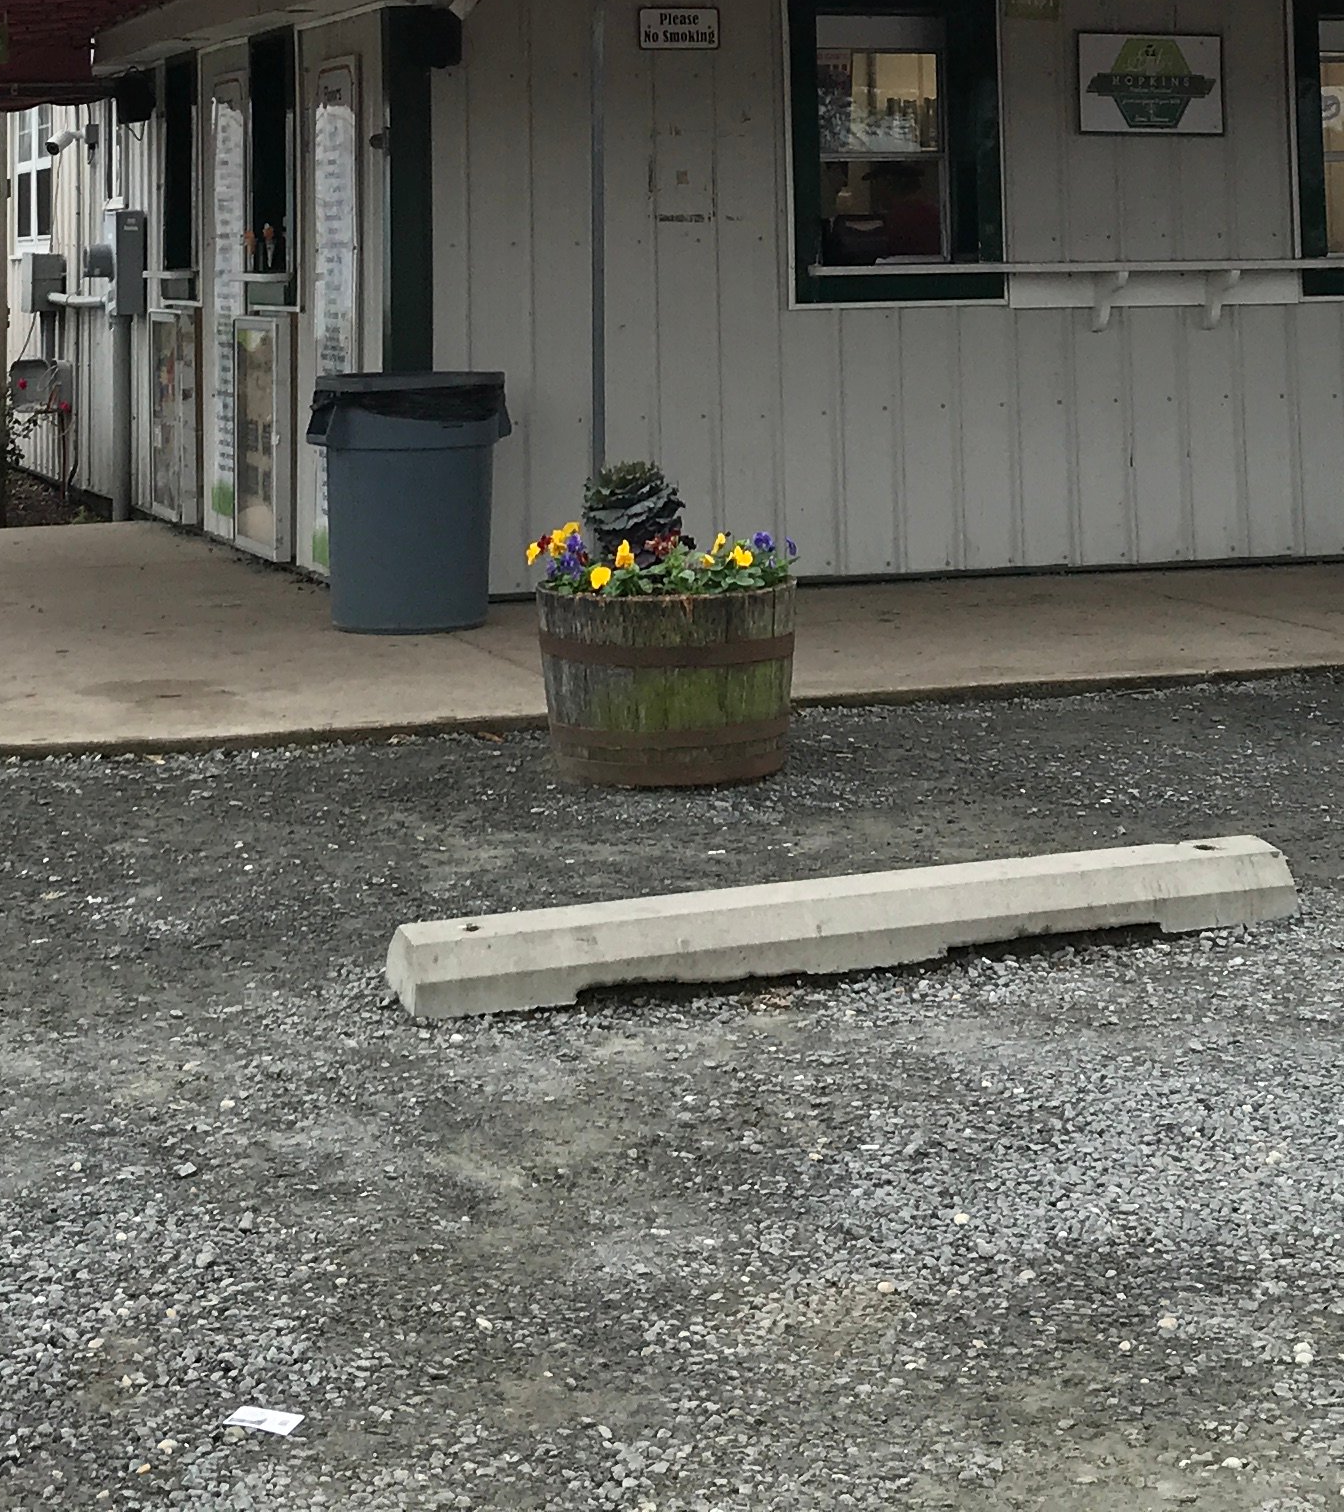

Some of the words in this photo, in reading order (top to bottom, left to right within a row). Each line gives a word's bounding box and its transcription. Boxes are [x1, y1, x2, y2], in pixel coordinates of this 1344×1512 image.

[659, 13, 699, 25] Please
[644, 30, 659, 43] No
[663, 29, 715, 44] Smoking
[1111, 76, 1191, 87] HOPKINS
